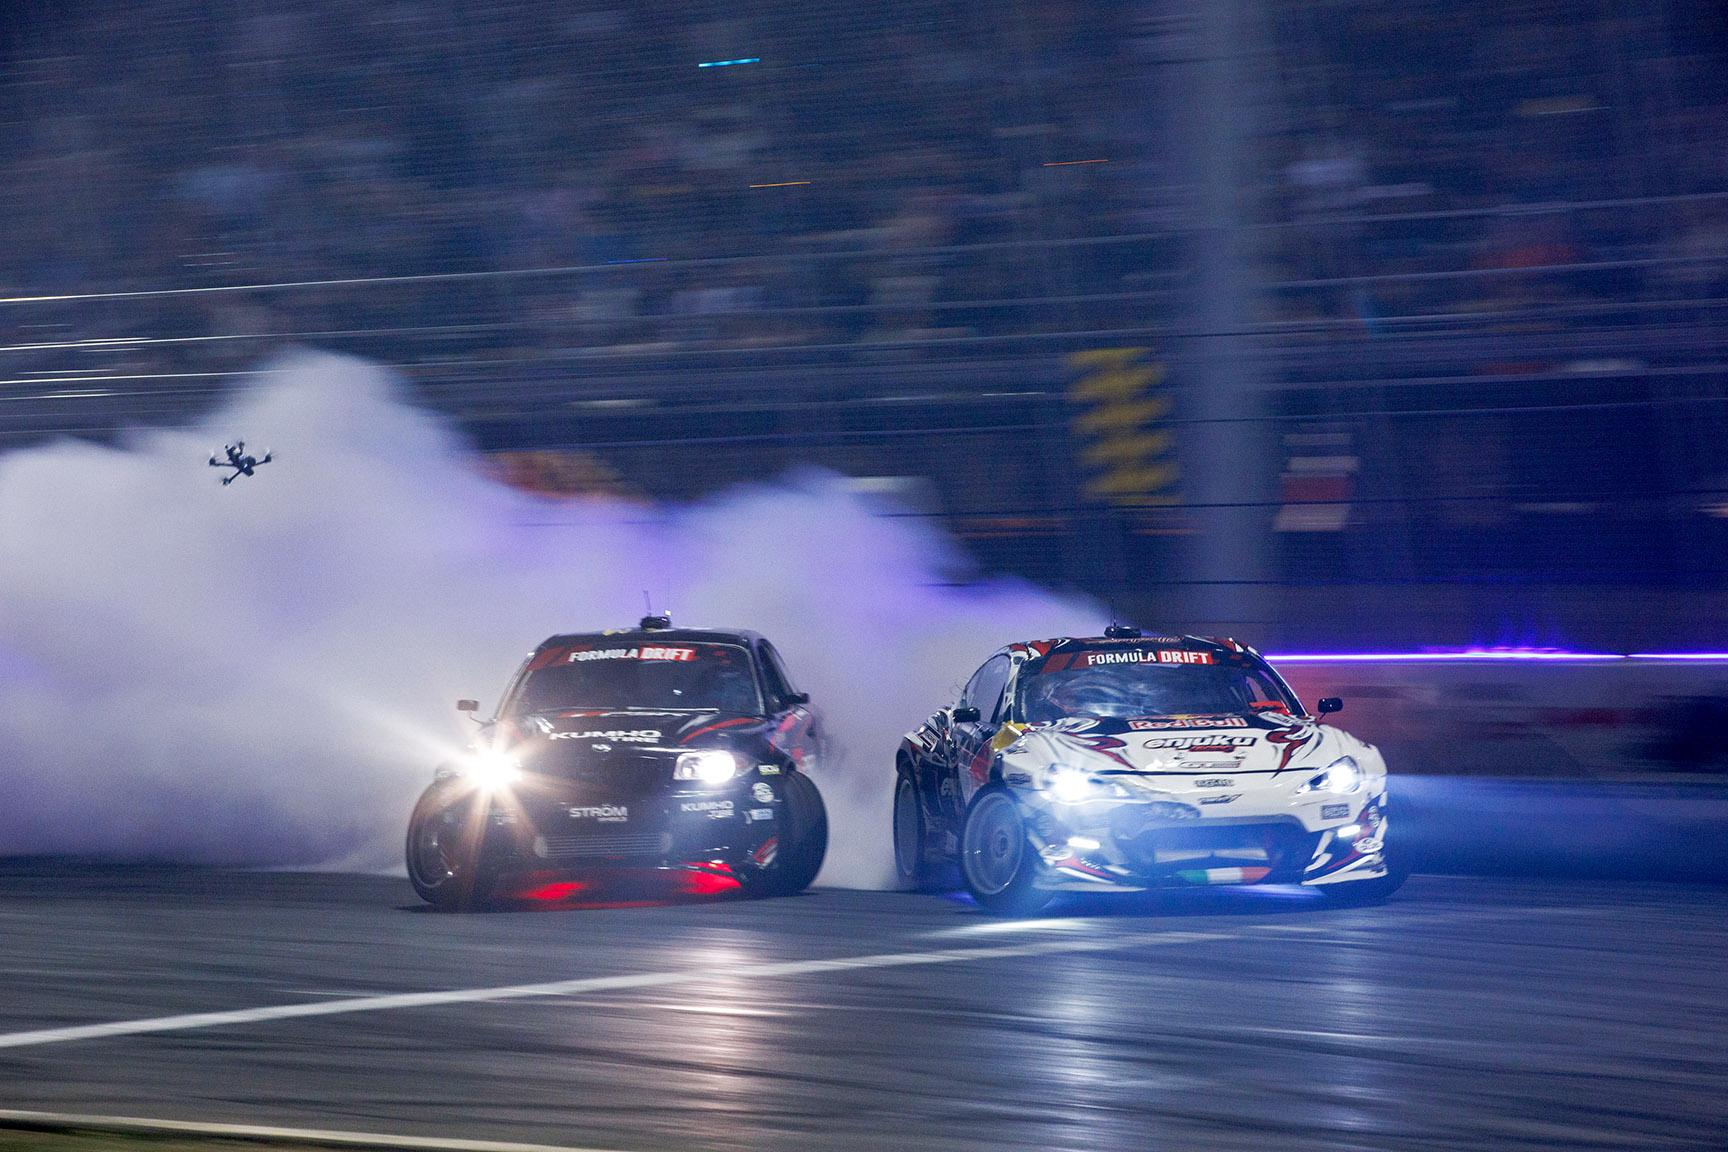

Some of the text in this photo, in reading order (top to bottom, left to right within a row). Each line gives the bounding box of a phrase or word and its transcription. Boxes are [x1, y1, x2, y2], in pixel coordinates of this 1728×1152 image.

[568, 647, 694, 662] FORMULA DRIFT
[1087, 651, 1209, 665] FORMULA DRIFT
[1128, 718, 1248, 730] Red Bull
[549, 730, 662, 740] KUMHO
[1143, 735, 1257, 750] enjuku
[569, 804, 628, 817] STRÖM
[681, 801, 734, 811] KUMHO
